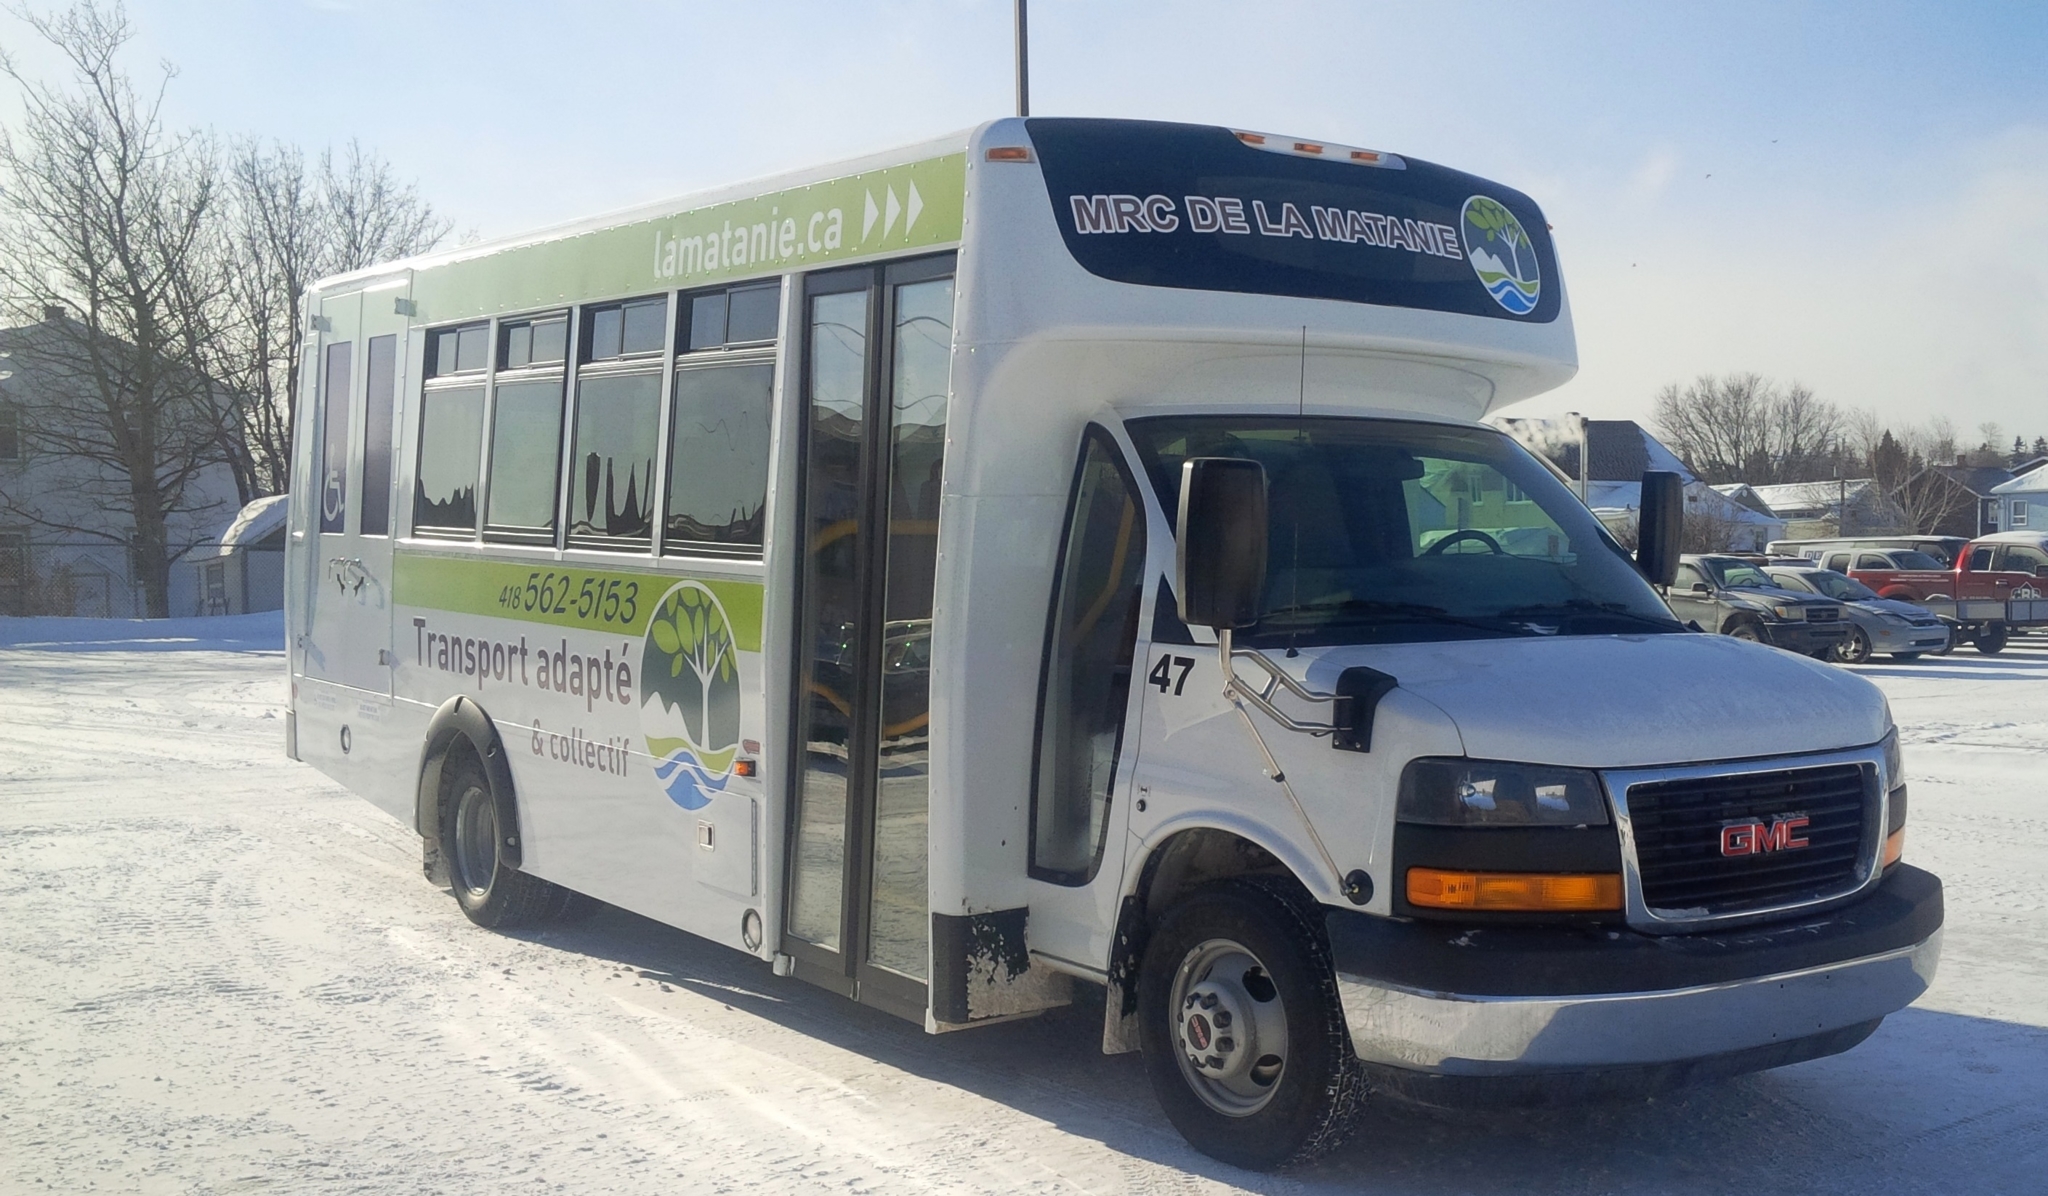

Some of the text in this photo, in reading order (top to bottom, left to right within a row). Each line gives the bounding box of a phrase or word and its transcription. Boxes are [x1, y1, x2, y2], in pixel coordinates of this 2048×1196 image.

[653, 206, 843, 279] lamatanie.ca
[1070, 194, 1463, 260] MRC DE LA MATANIE
[498, 572, 638, 624] 418 562-5153
[413, 618, 632, 713] Transport adapté
[1149, 654, 1195, 696] 47
[531, 717, 630, 777] & collectif
[1721, 816, 1809, 857] GMC
